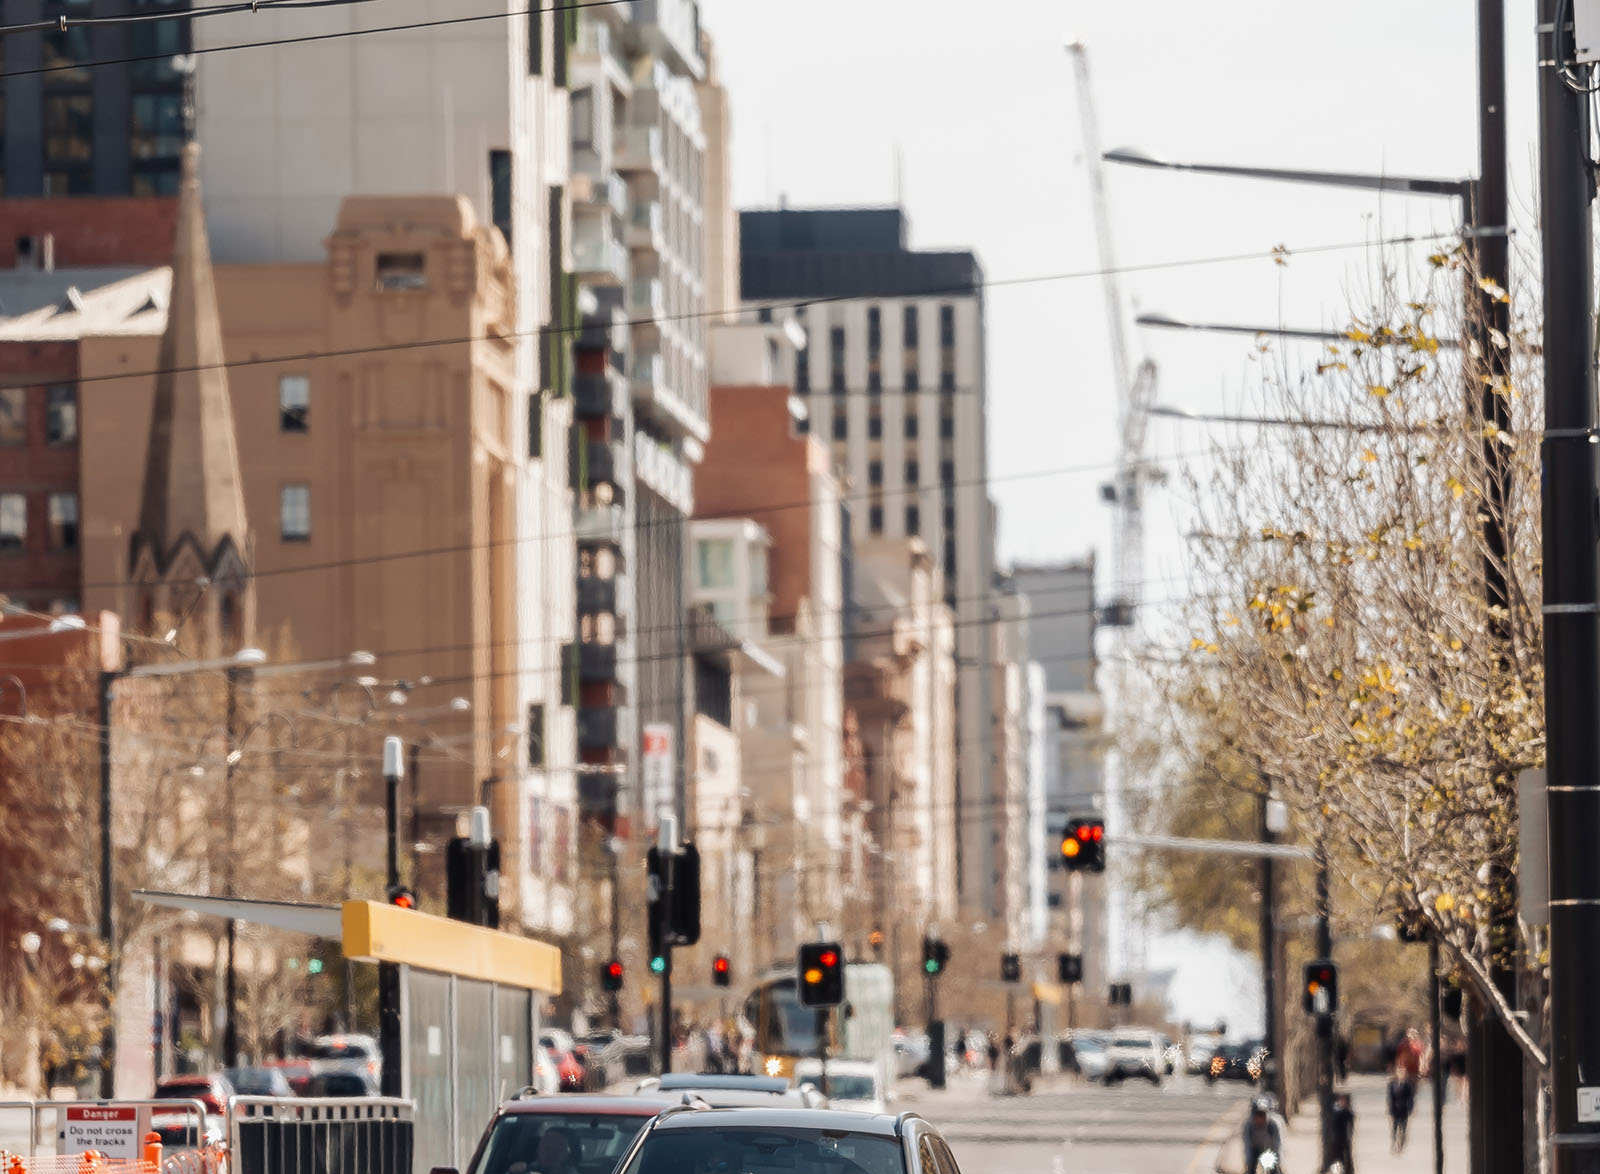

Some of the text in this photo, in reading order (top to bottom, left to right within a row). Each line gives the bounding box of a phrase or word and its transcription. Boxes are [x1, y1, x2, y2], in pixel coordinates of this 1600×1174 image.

[82, 1109, 120, 1120] Danger
[69, 1126, 133, 1135] Do not cross
[76, 1138, 126, 1146] the tracks
